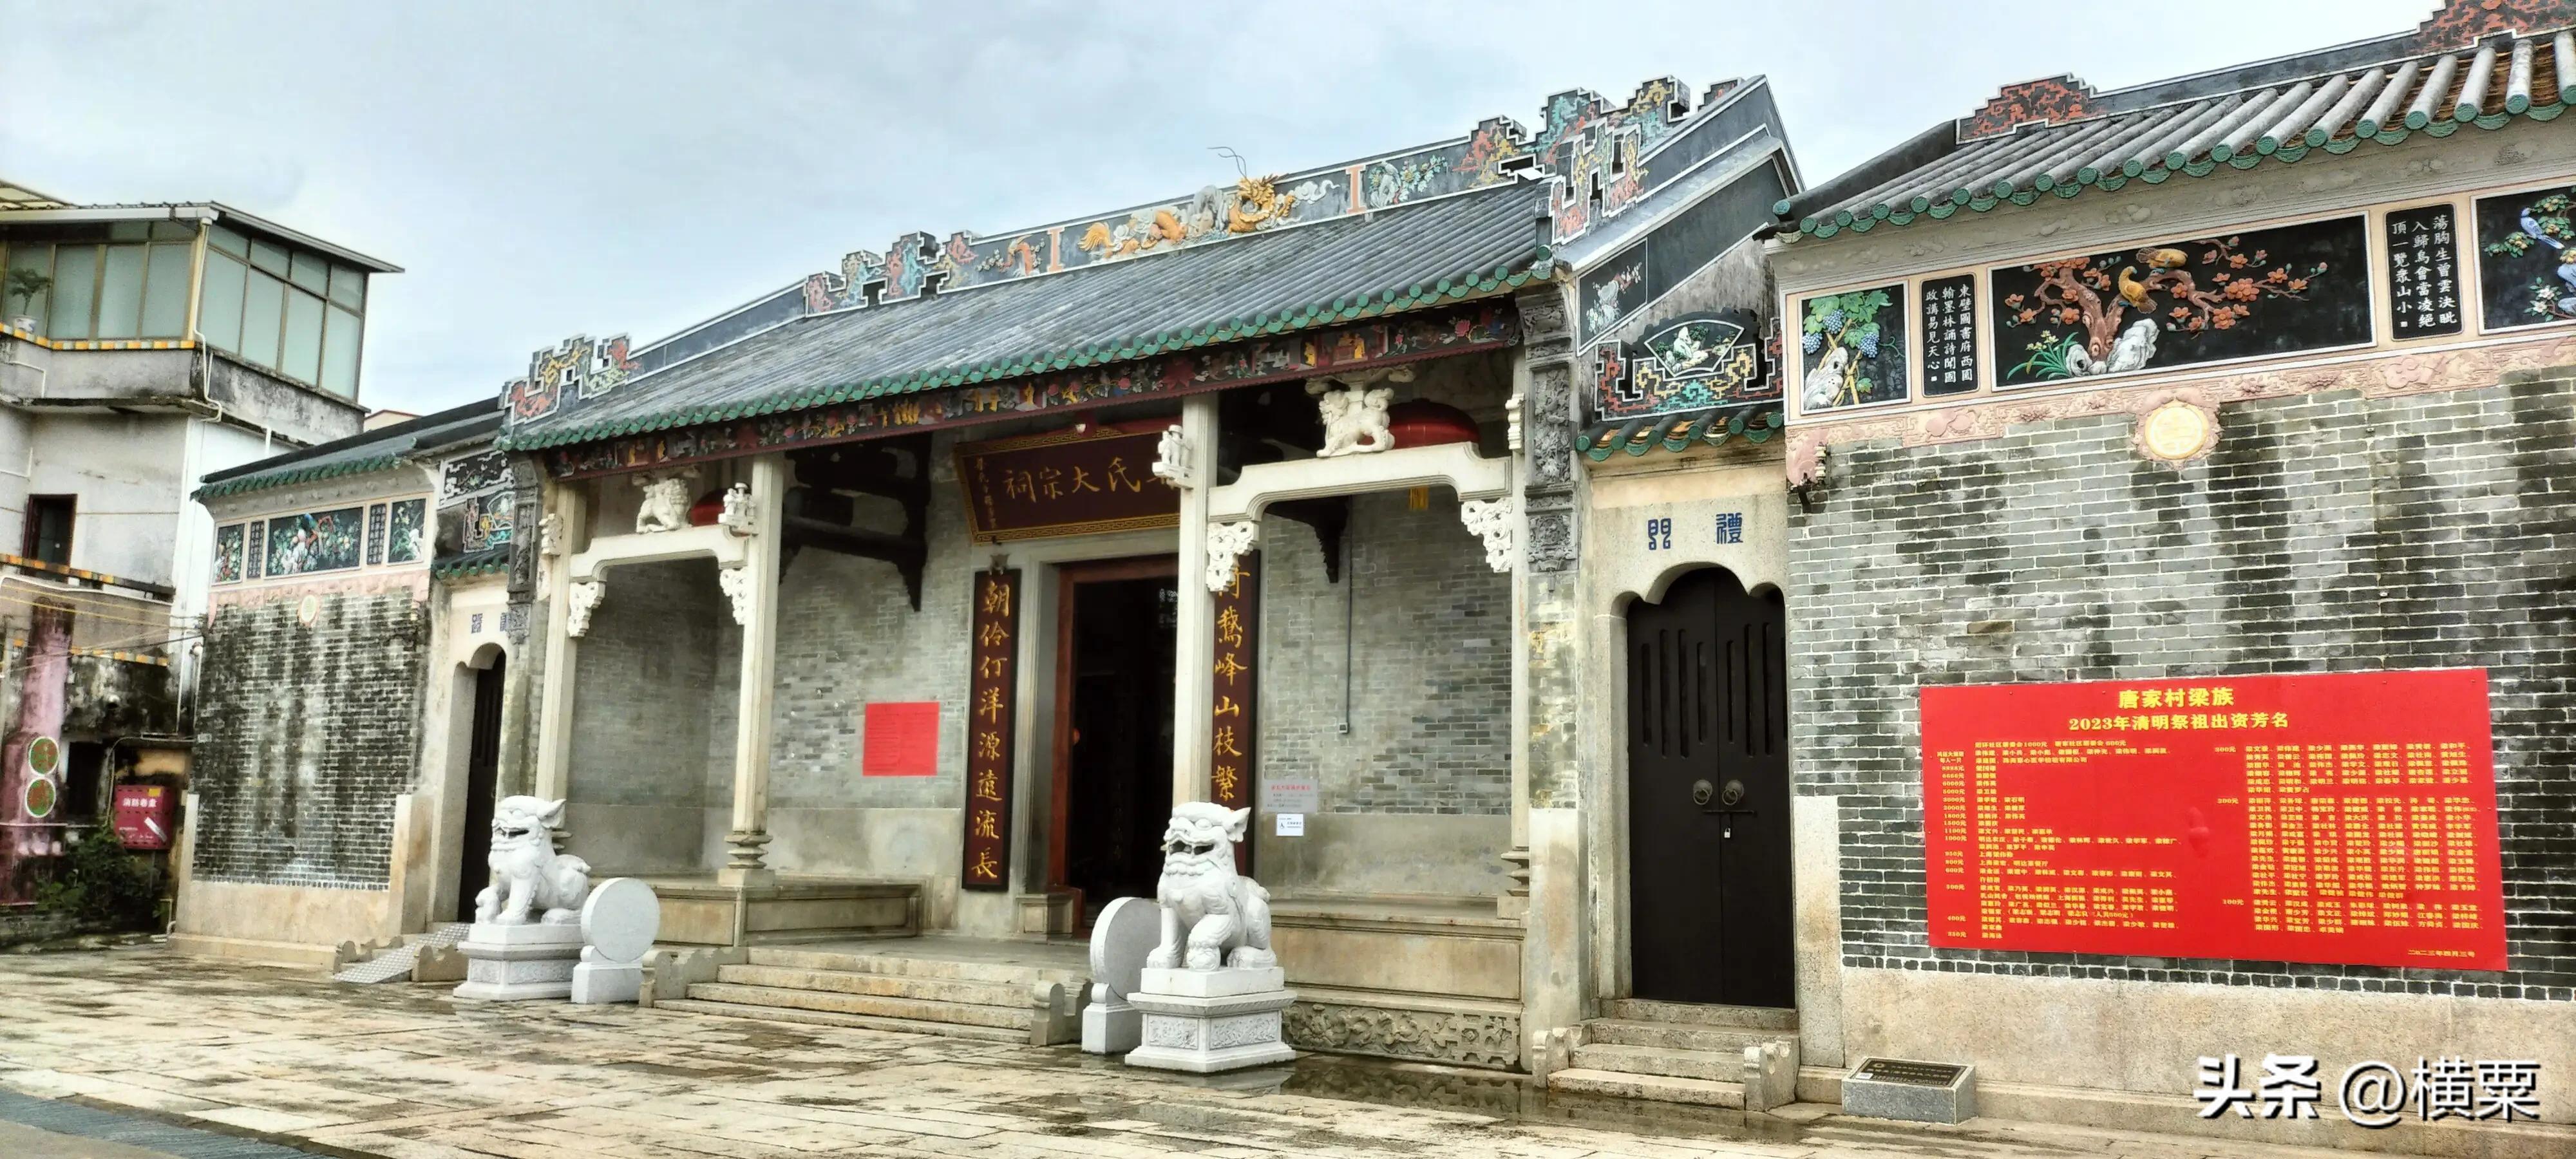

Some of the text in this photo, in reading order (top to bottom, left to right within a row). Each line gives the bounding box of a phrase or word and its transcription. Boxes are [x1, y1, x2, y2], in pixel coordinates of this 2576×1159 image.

[1003, 456, 1177, 503] 氏大宗祠
[2119, 687, 2234, 709] 唐家村梁族
[2069, 712, 2288, 731] 2023年清明祭祖出资芳名
